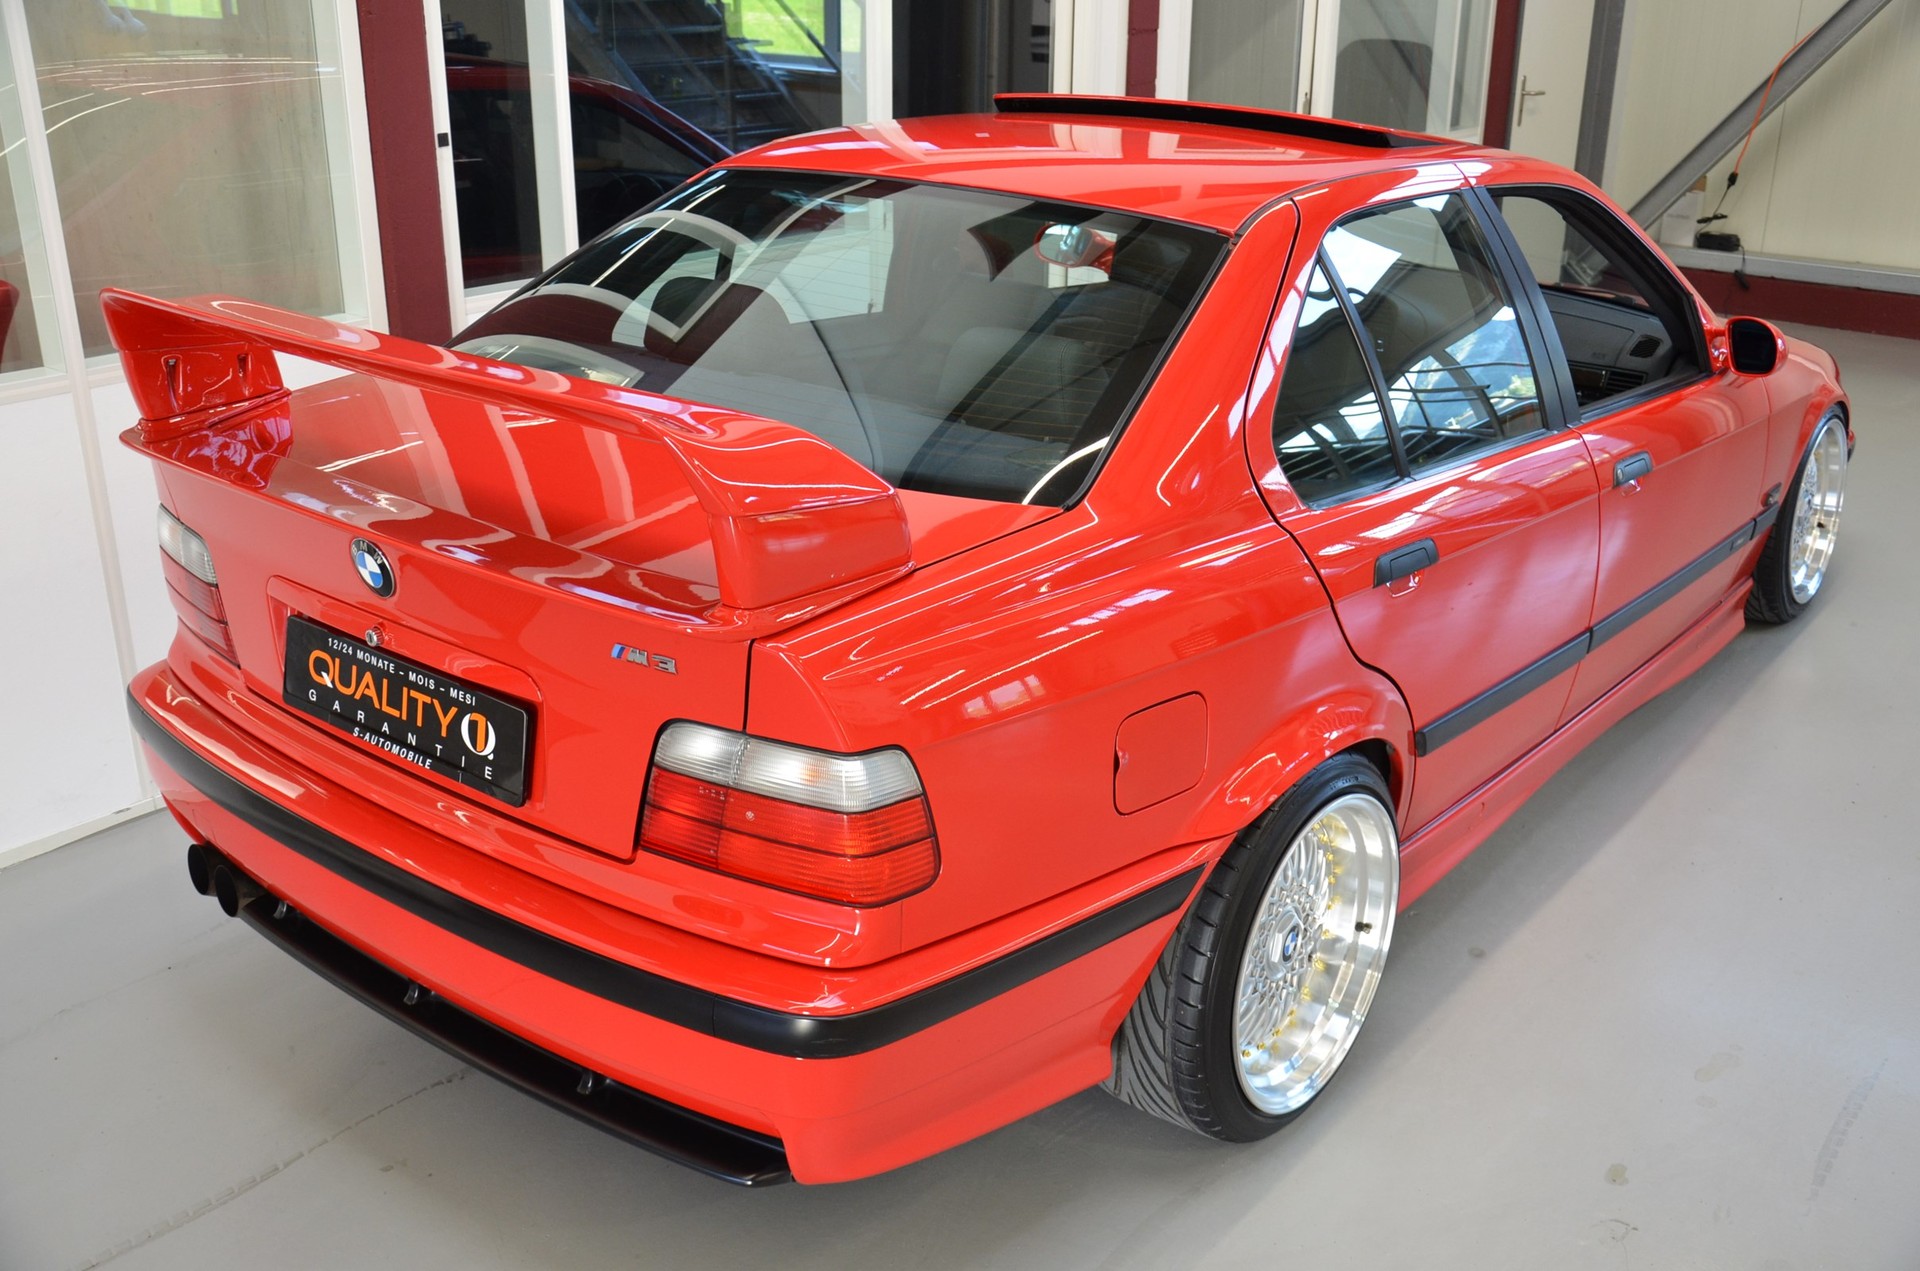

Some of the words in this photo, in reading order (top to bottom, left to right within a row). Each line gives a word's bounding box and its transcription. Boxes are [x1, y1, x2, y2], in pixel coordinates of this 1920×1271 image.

[351, 540, 383, 564] BMW
[328, 637, 353, 656] 12/24
[357, 649, 395, 674] MONATE
[408, 671, 435, 690] MOIS
[450, 687, 476, 706] MESI
[624, 647, 678, 675] M3
[308, 650, 458, 738] QUALITY
[352, 727, 433, 770] S-AUTOMOBILE
